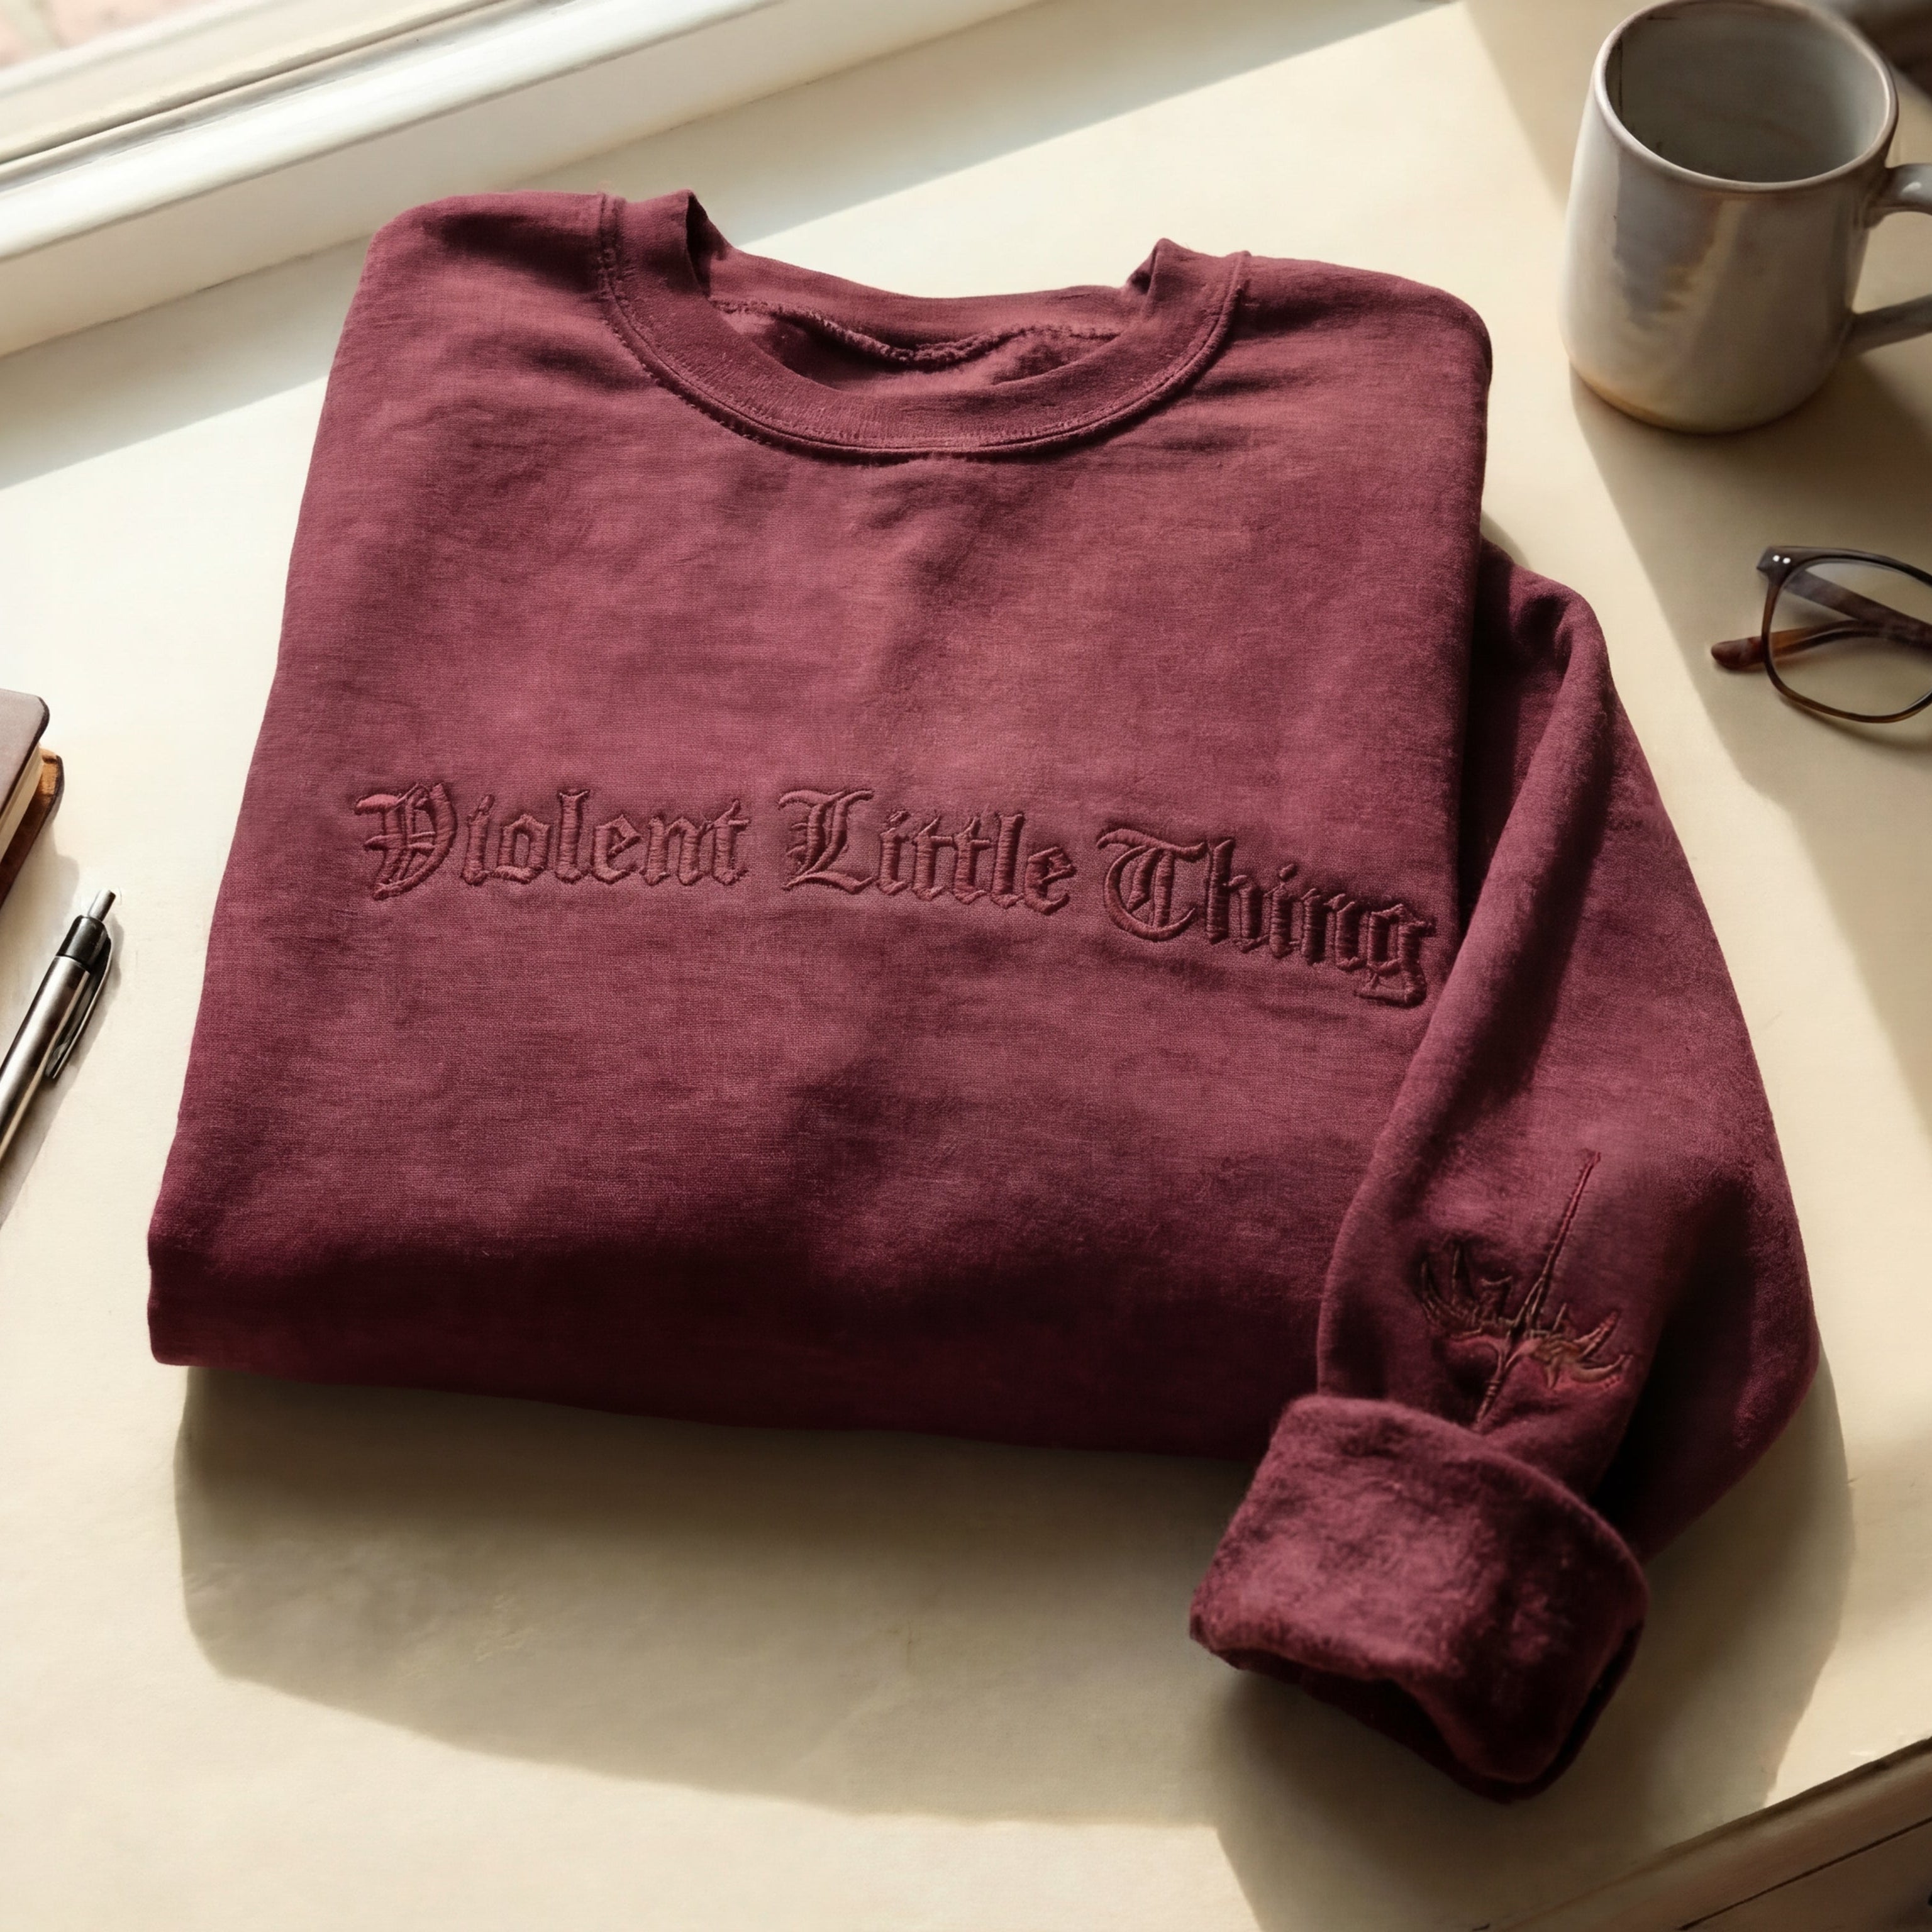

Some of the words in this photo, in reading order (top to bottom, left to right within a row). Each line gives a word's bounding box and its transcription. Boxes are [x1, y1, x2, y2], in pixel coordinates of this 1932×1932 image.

[355, 782, 751, 900] Violent
[777, 788, 1077, 914] Little
[1096, 827, 1436, 1008] Thing
